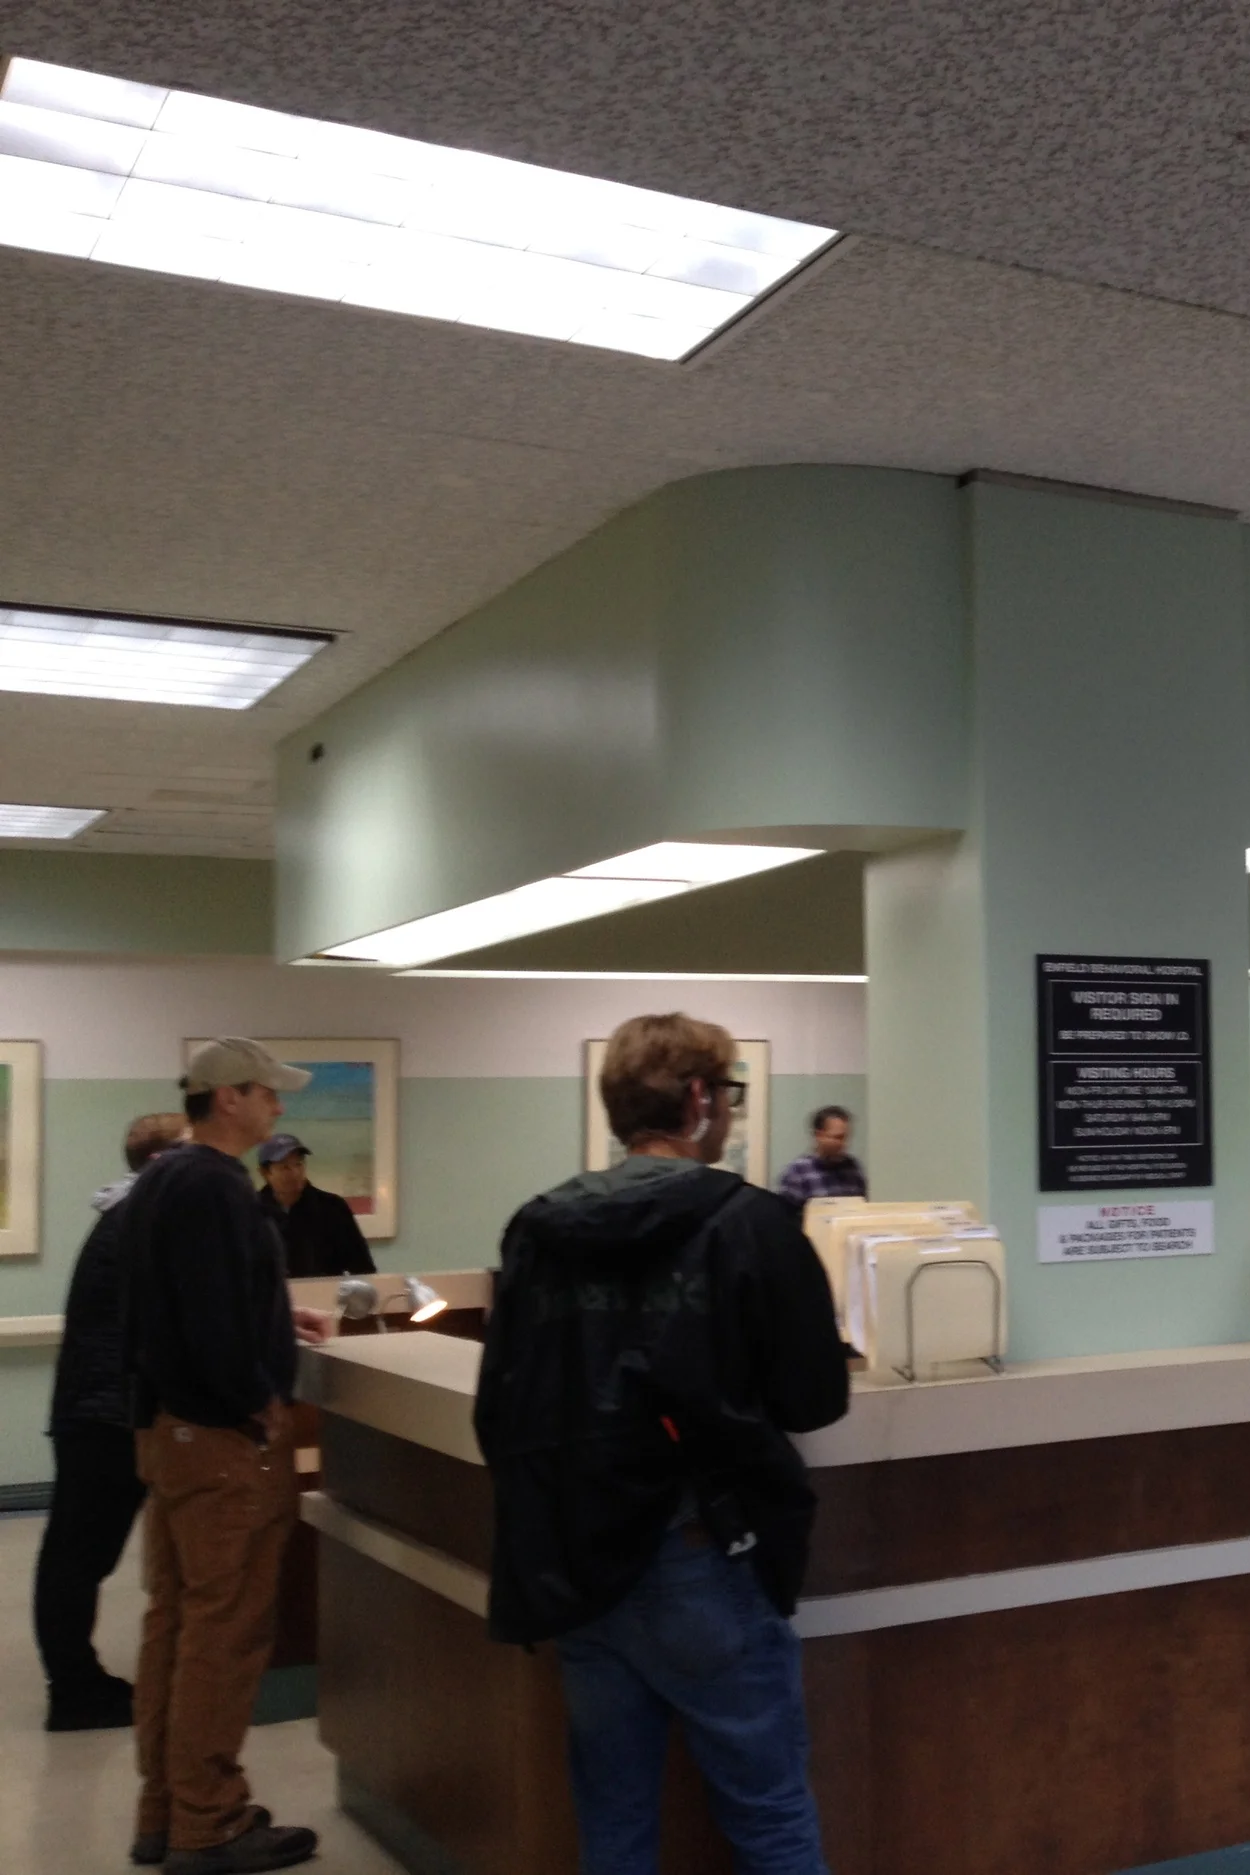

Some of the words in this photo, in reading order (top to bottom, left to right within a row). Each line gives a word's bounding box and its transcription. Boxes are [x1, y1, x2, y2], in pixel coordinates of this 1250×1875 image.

[1090, 963, 1154, 975] BEHAVIORAL
[1155, 965, 1203, 976] HOSPITAL
[1071, 990, 1128, 1004] VISITOR
[1130, 992, 1163, 1005] SIGN
[1165, 993, 1180, 1005] IN
[1089, 1007, 1162, 1021] REQUIRED
[1058, 1030, 1074, 1040] BE
[1076, 1030, 1129, 1040] PREPARED
[1130, 1031, 1143, 1040] TO
[1145, 1031, 1174, 1040] SHOW
[1076, 1067, 1132, 1079] VISITING
[1133, 1067, 1176, 1079] HOURS
[1099, 1205, 1156, 1217] NOTICE
[1085, 1220, 1105, 1230] ALL
[1141, 1217, 1171, 1227] FOOD
[1069, 1231, 1126, 1243] PACKAGES
[1127, 1230, 1148, 1240] FOR
[1150, 1228, 1197, 1239] PATIENTS
[1062, 1245, 1085, 1256] ARE
[1087, 1243, 1134, 1255] SUBJECT
[1135, 1242, 1149, 1252] TO
[1151, 1240, 1194, 1251] SEARCH
